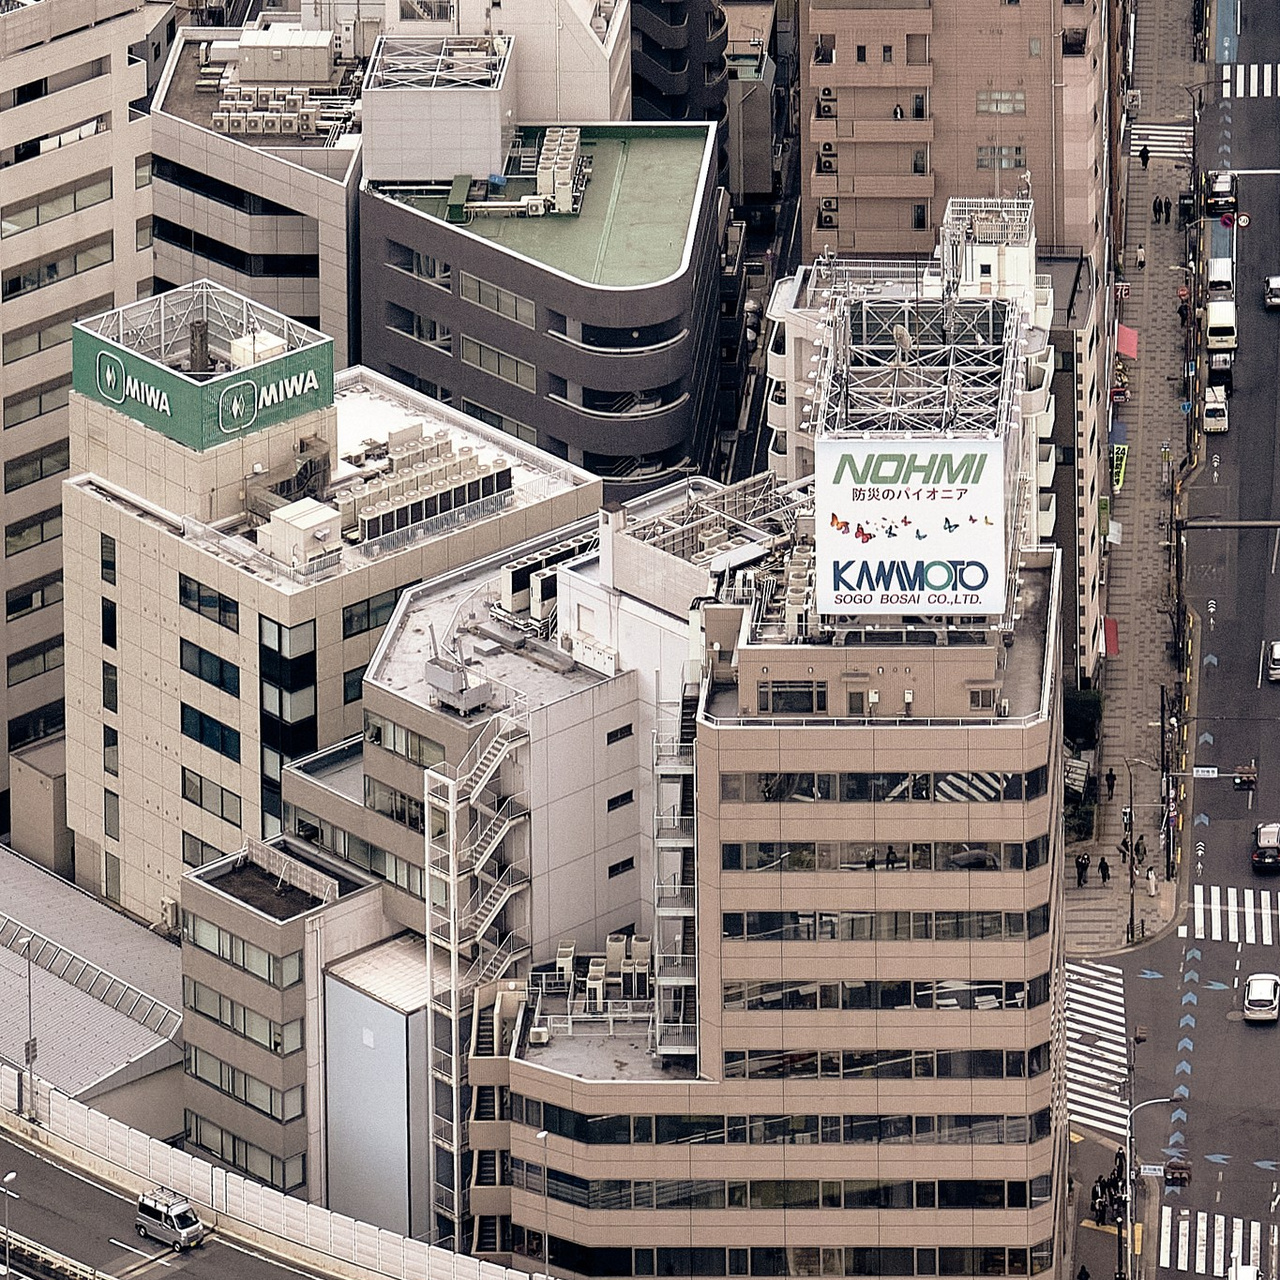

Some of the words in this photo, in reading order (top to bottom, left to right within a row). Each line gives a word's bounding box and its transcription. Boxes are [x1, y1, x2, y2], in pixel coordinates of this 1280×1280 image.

[125, 375, 171, 417] MIWA
[258, 370, 319, 409] MIWA
[832, 453, 988, 485] NOHMI
[852, 487, 969, 502] 防災のパイオニア
[834, 593, 873, 605] SOGO
[880, 593, 920, 605] BOSAI
[927, 593, 982, 606] CO.,LTD.
